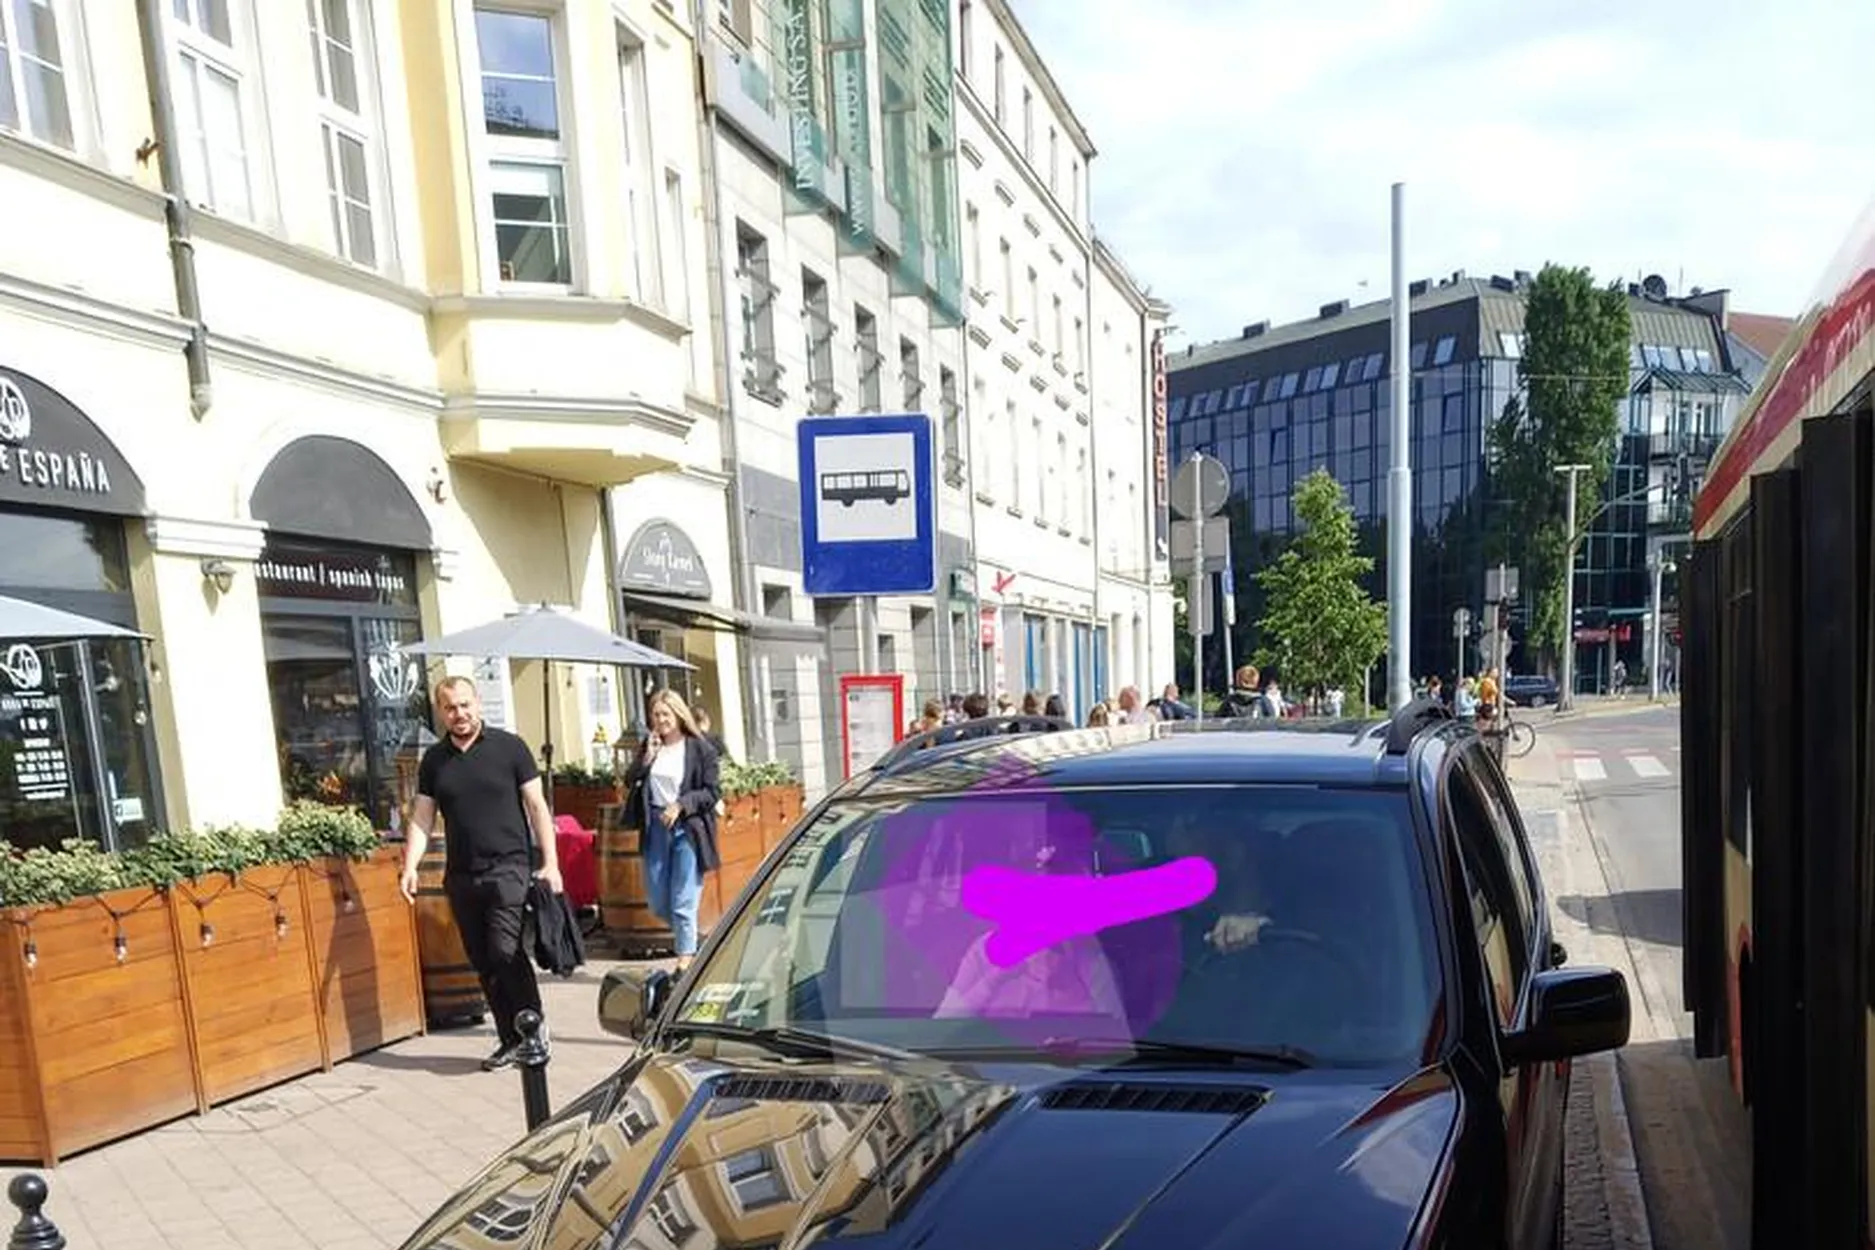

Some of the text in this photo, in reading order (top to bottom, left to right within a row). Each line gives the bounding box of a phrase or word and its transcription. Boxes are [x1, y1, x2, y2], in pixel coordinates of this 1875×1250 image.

[1154, 342, 1167, 507] HOSTEL
[18, 448, 111, 493] ESPAÑA
[253, 561, 316, 583] estaurant
[374, 571, 405, 594] tapas
